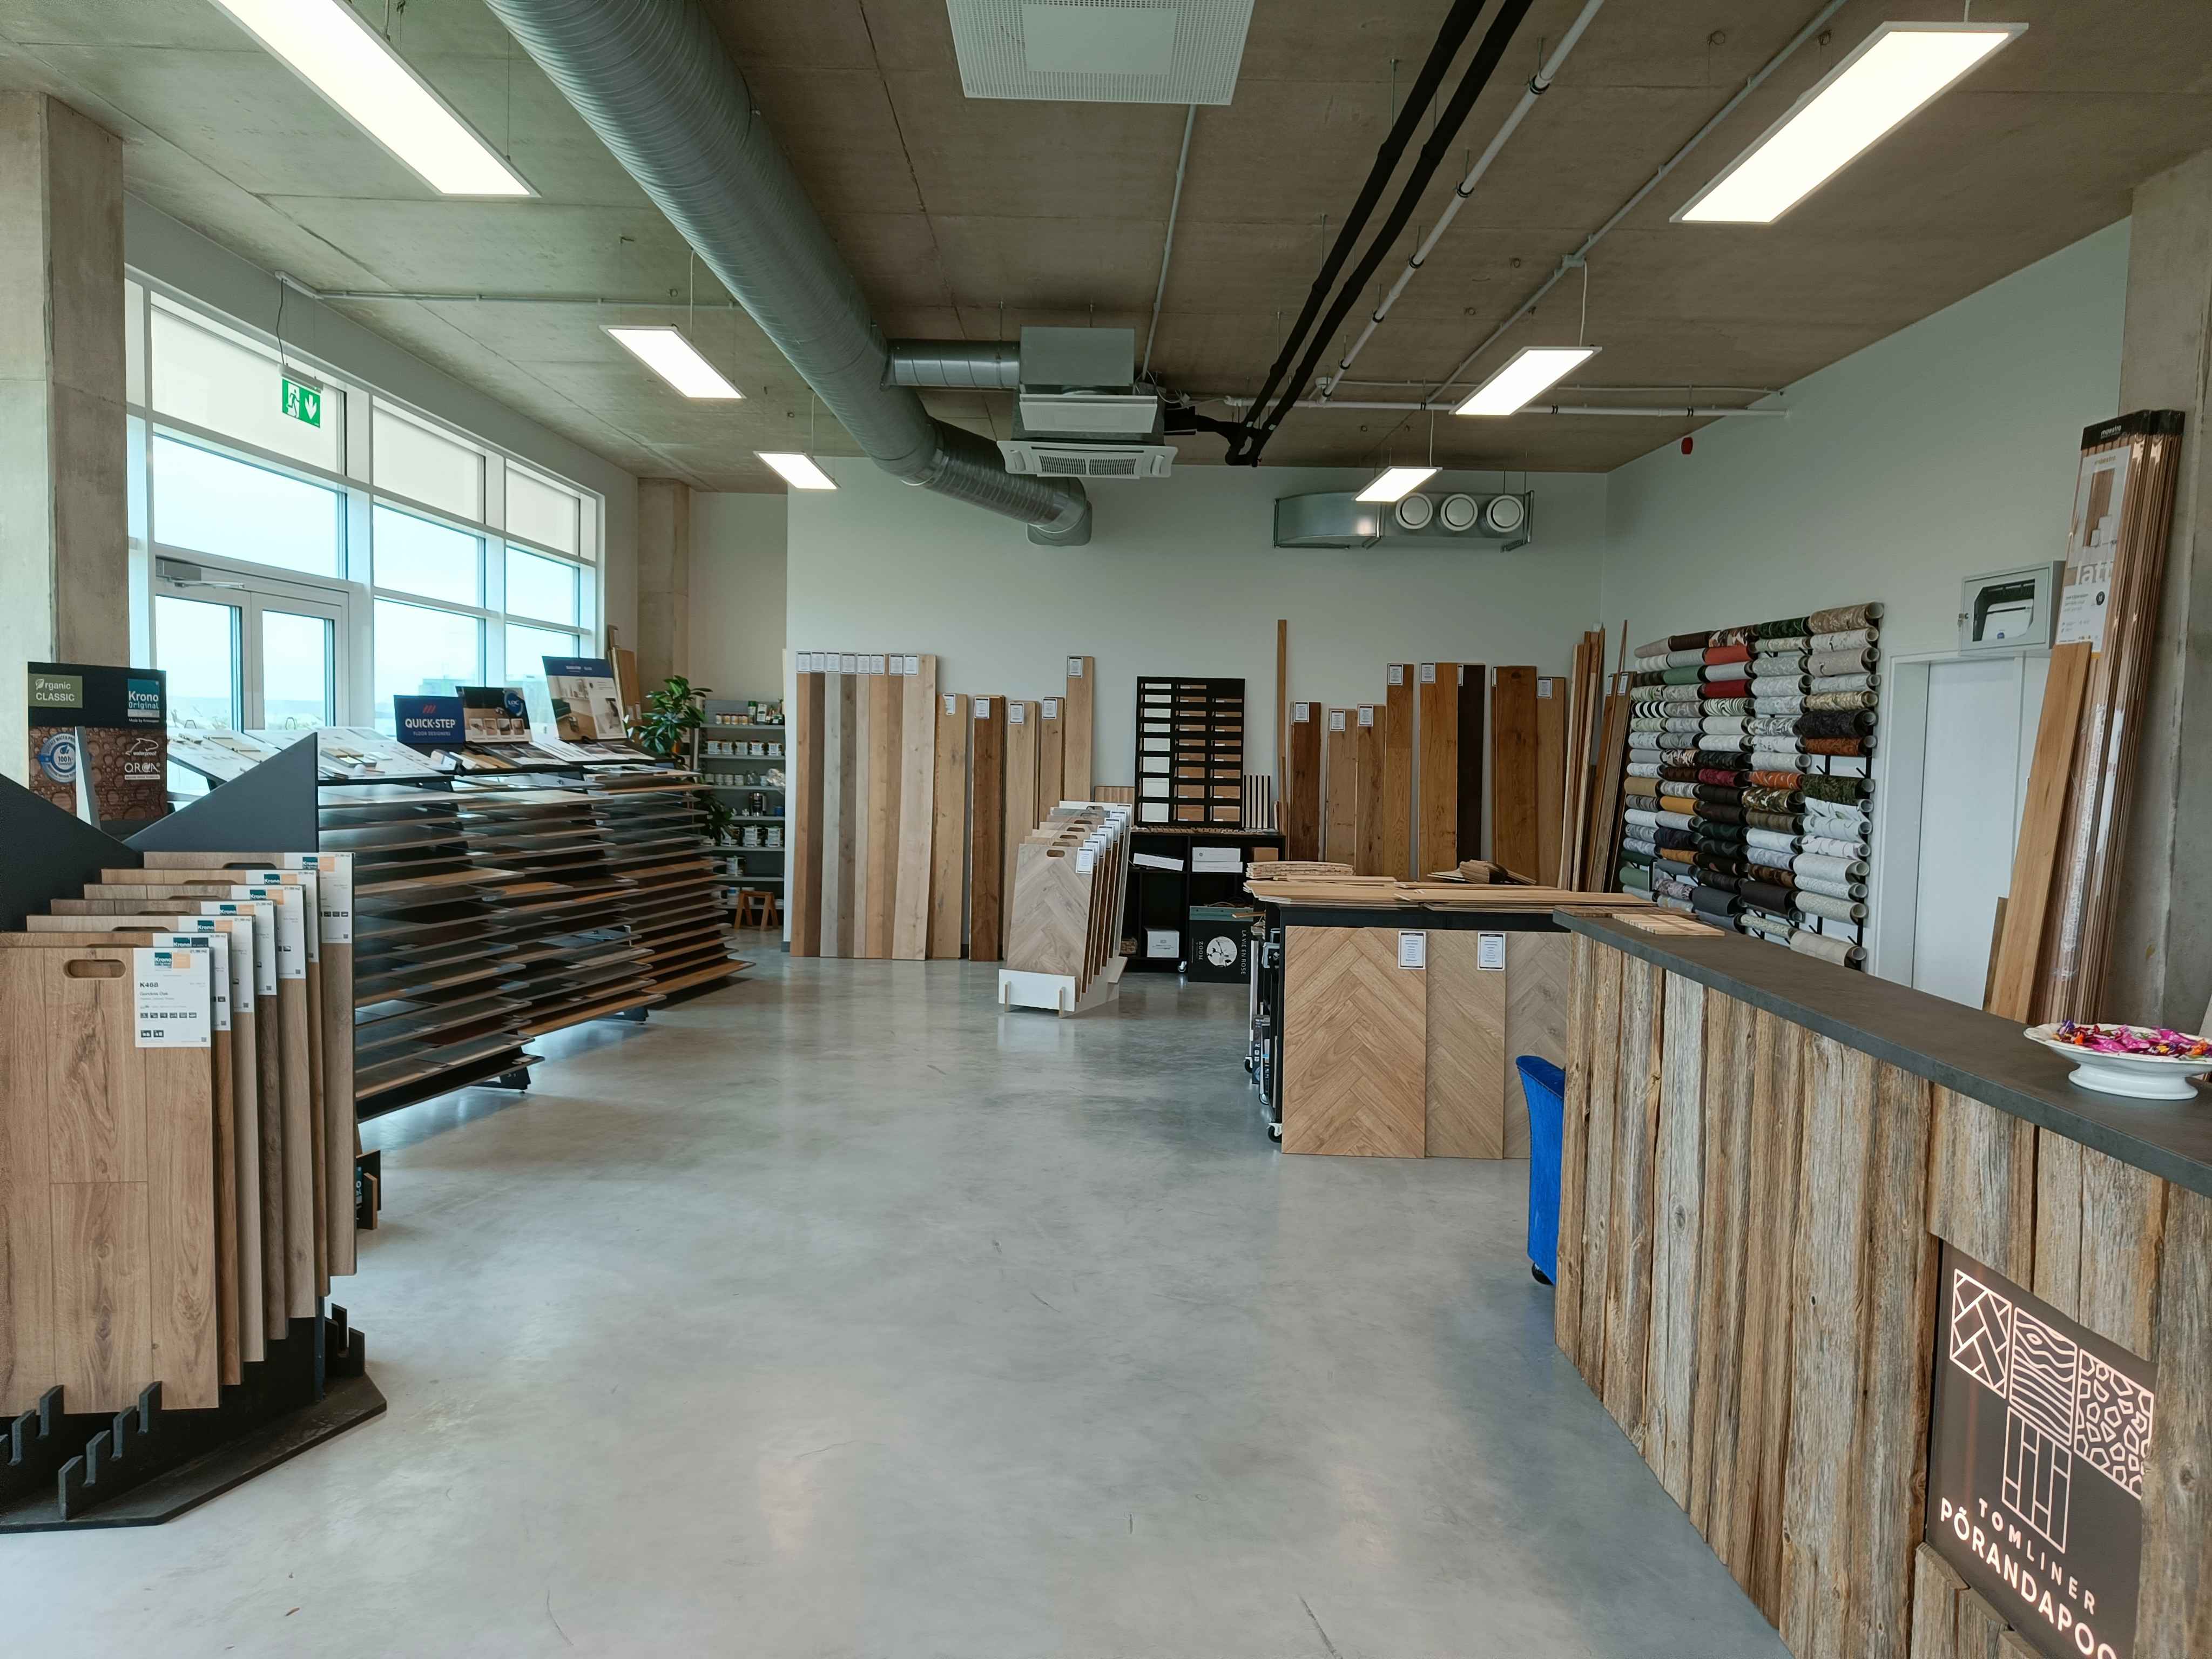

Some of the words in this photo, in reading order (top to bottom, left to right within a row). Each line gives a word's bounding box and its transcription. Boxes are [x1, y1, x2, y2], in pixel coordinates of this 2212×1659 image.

[36, 692, 75, 702] CLASSIC
[129, 691, 159, 702] Krono
[129, 702, 159, 710] Original
[1978, 1498, 2095, 1615] TOMLINER
